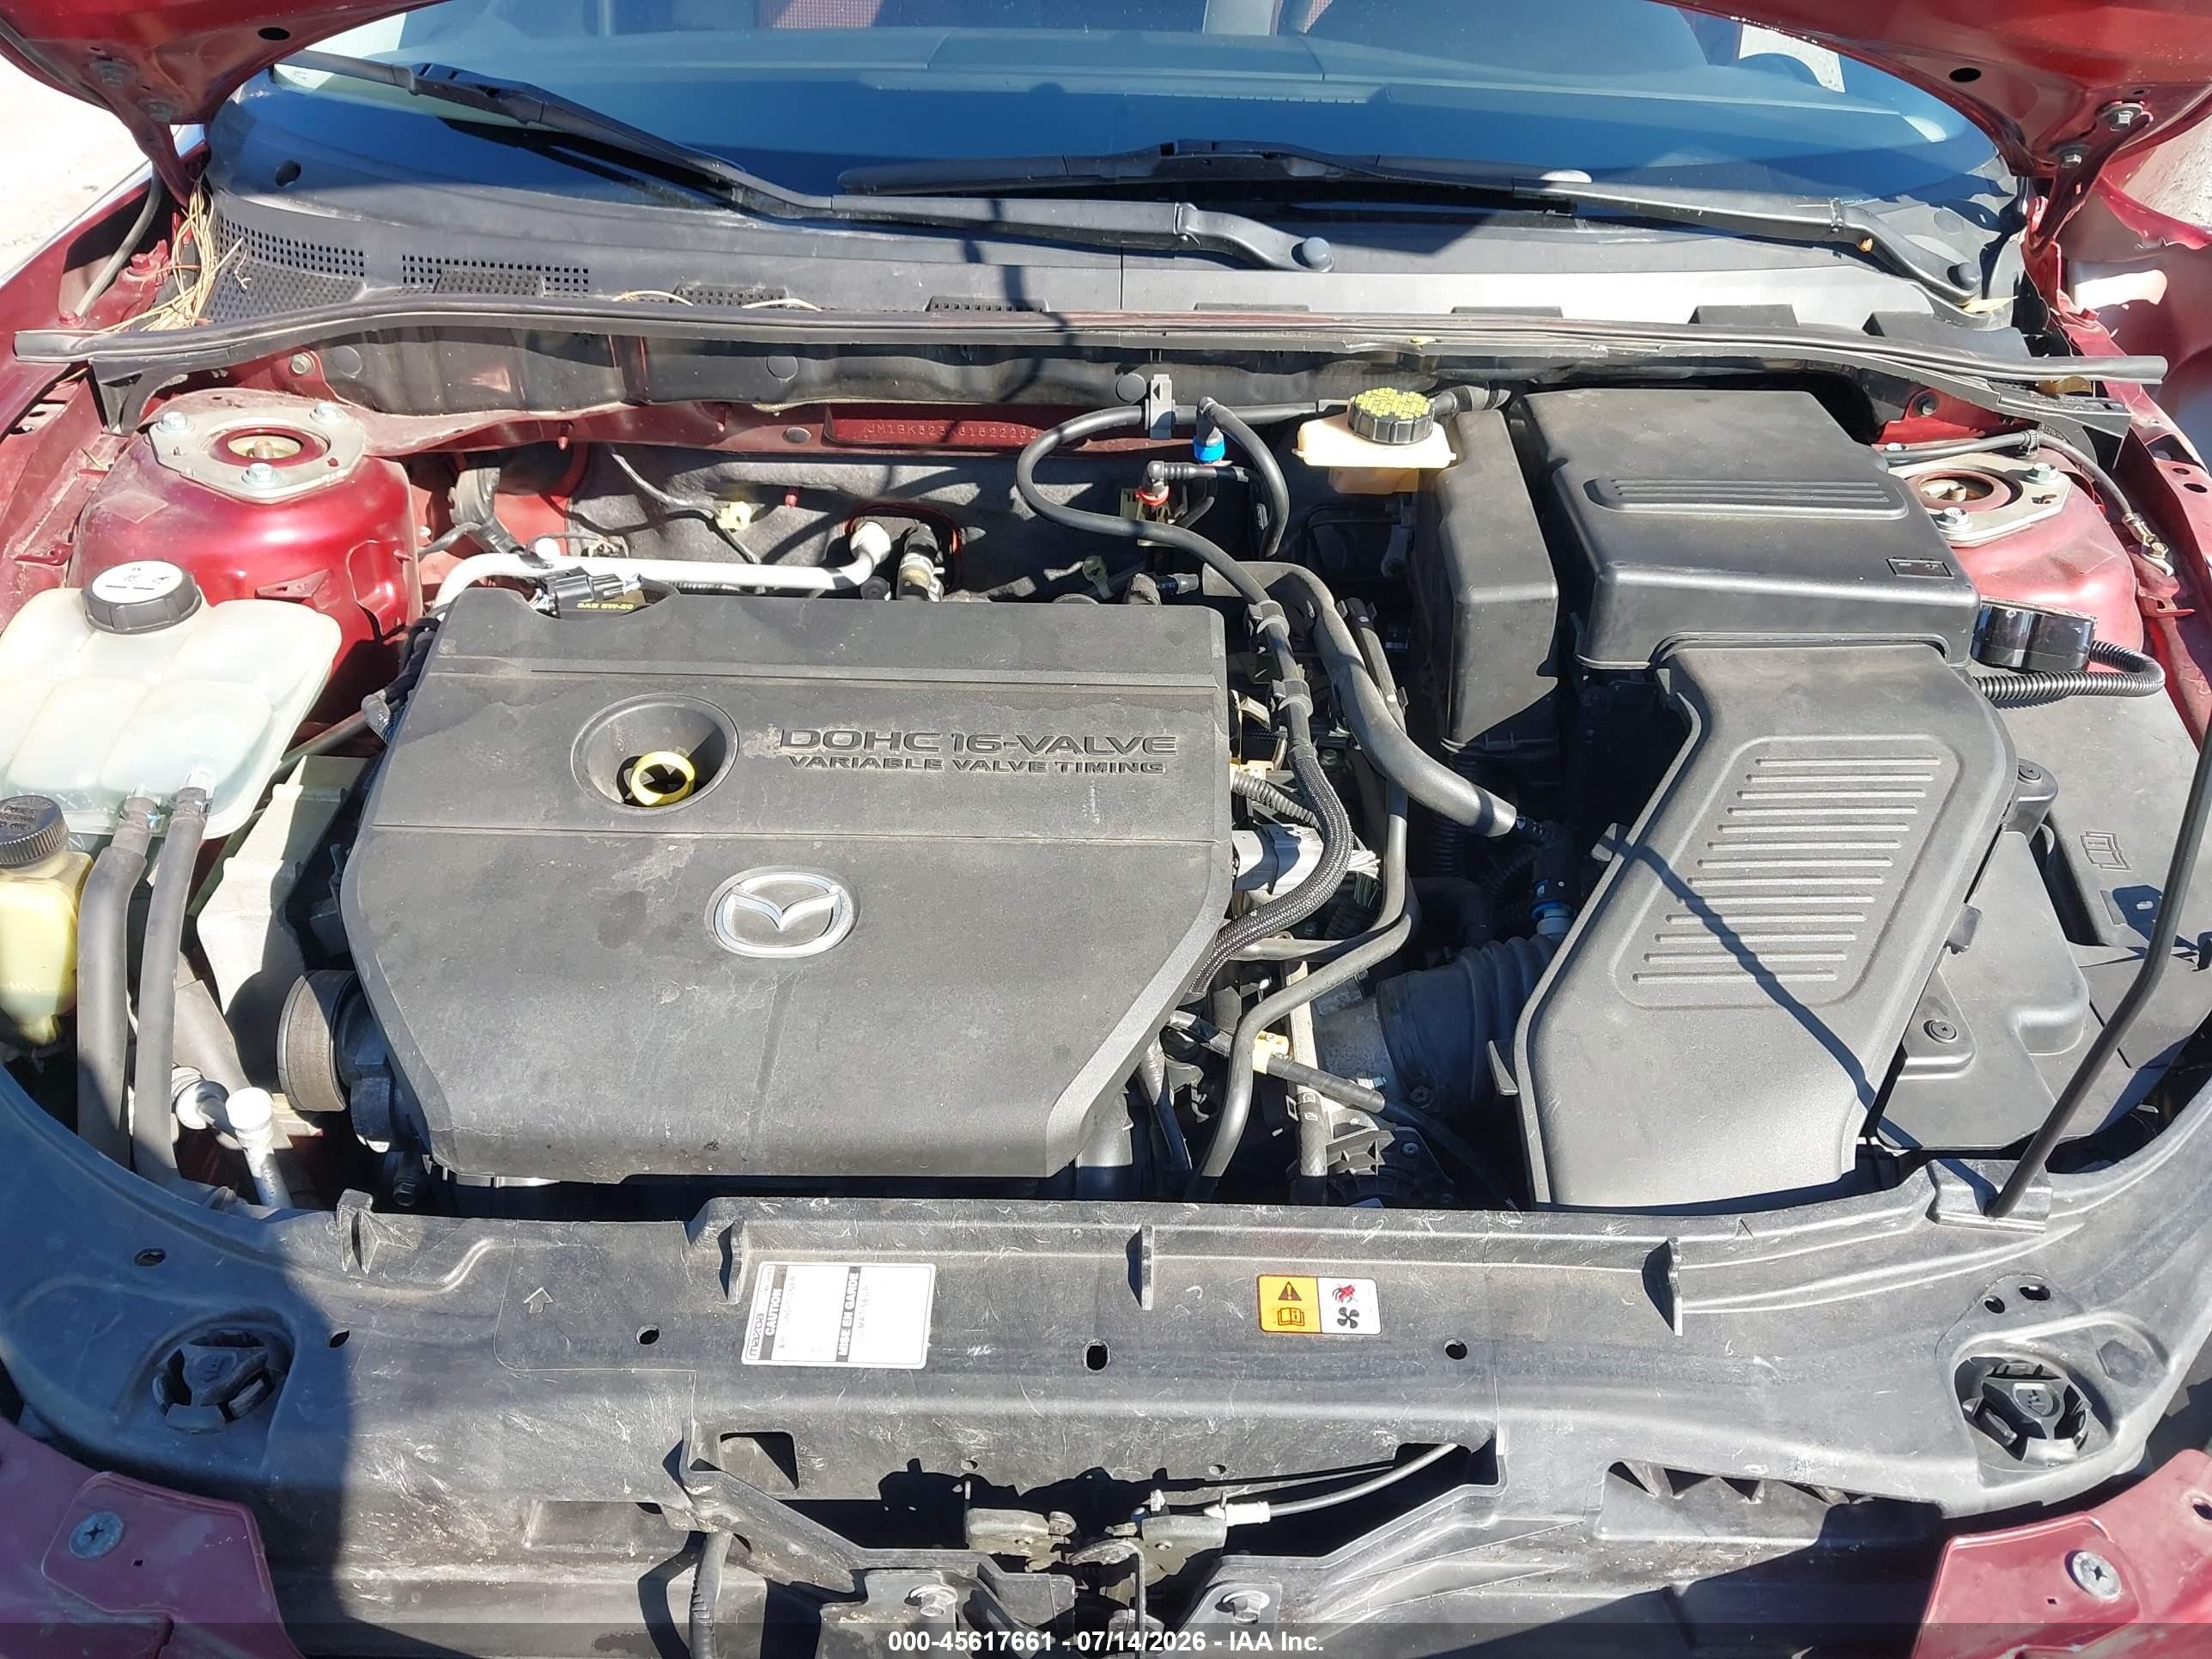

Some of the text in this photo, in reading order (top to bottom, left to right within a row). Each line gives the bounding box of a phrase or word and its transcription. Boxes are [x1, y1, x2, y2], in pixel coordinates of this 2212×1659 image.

[780, 729, 1178, 757] DOHC 16-VALVE
[788, 756, 1165, 775] VARIABLE VALVE TIMING
[764, 1288, 783, 1337] CAUTION
[837, 1273, 860, 1356] MISE EN GARDE
